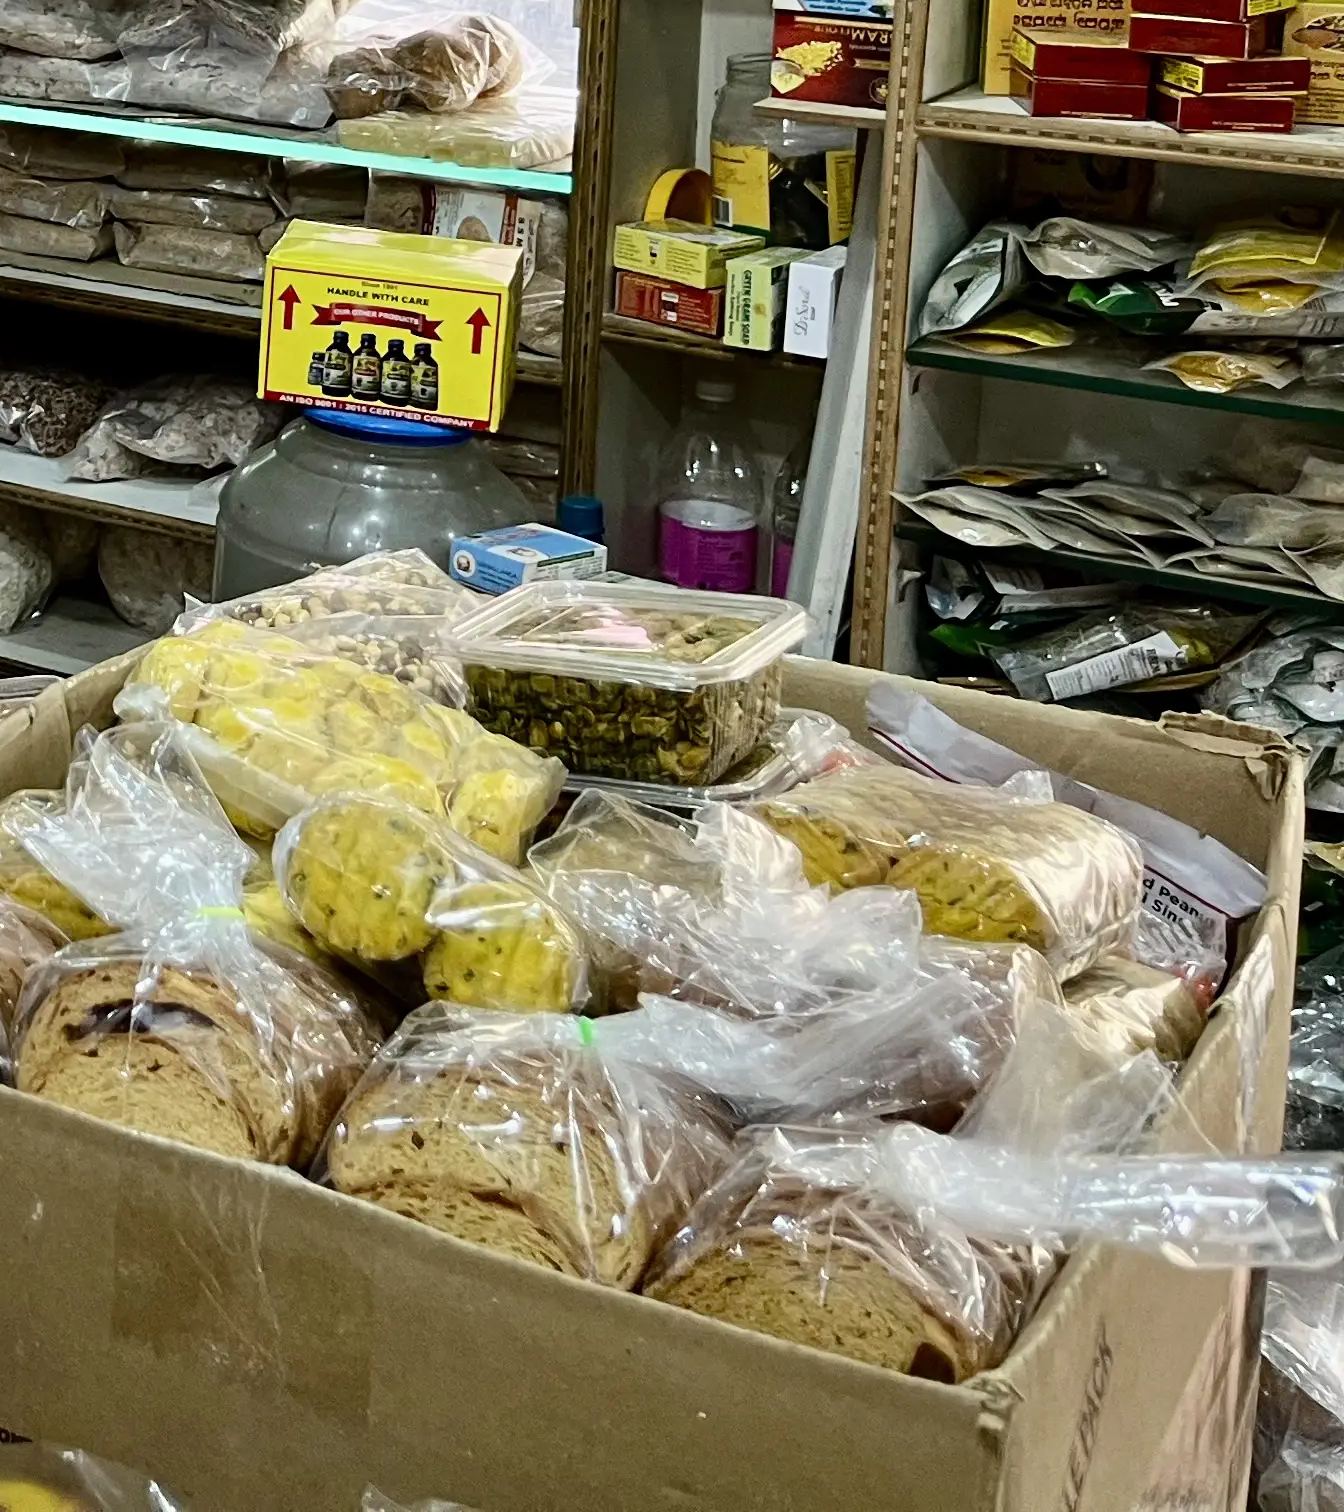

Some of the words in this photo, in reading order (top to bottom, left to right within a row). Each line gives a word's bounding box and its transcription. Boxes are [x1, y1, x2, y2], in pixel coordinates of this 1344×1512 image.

[327, 287, 369, 299] HANDLE
[371, 292, 399, 303] WITH
[401, 295, 430, 306] CARE
[333, 308, 351, 317] OUR
[351, 310, 377, 319] OTHER
[378, 312, 420, 326] PRODUCTS
[279, 394, 294, 403] AN
[295, 396, 313, 406] ISO
[314, 399, 337, 410] 9001
[344, 402, 367, 413] 2015
[368, 406, 422, 422] CERTIFIED
[423, 413, 475, 428] COMPANY
